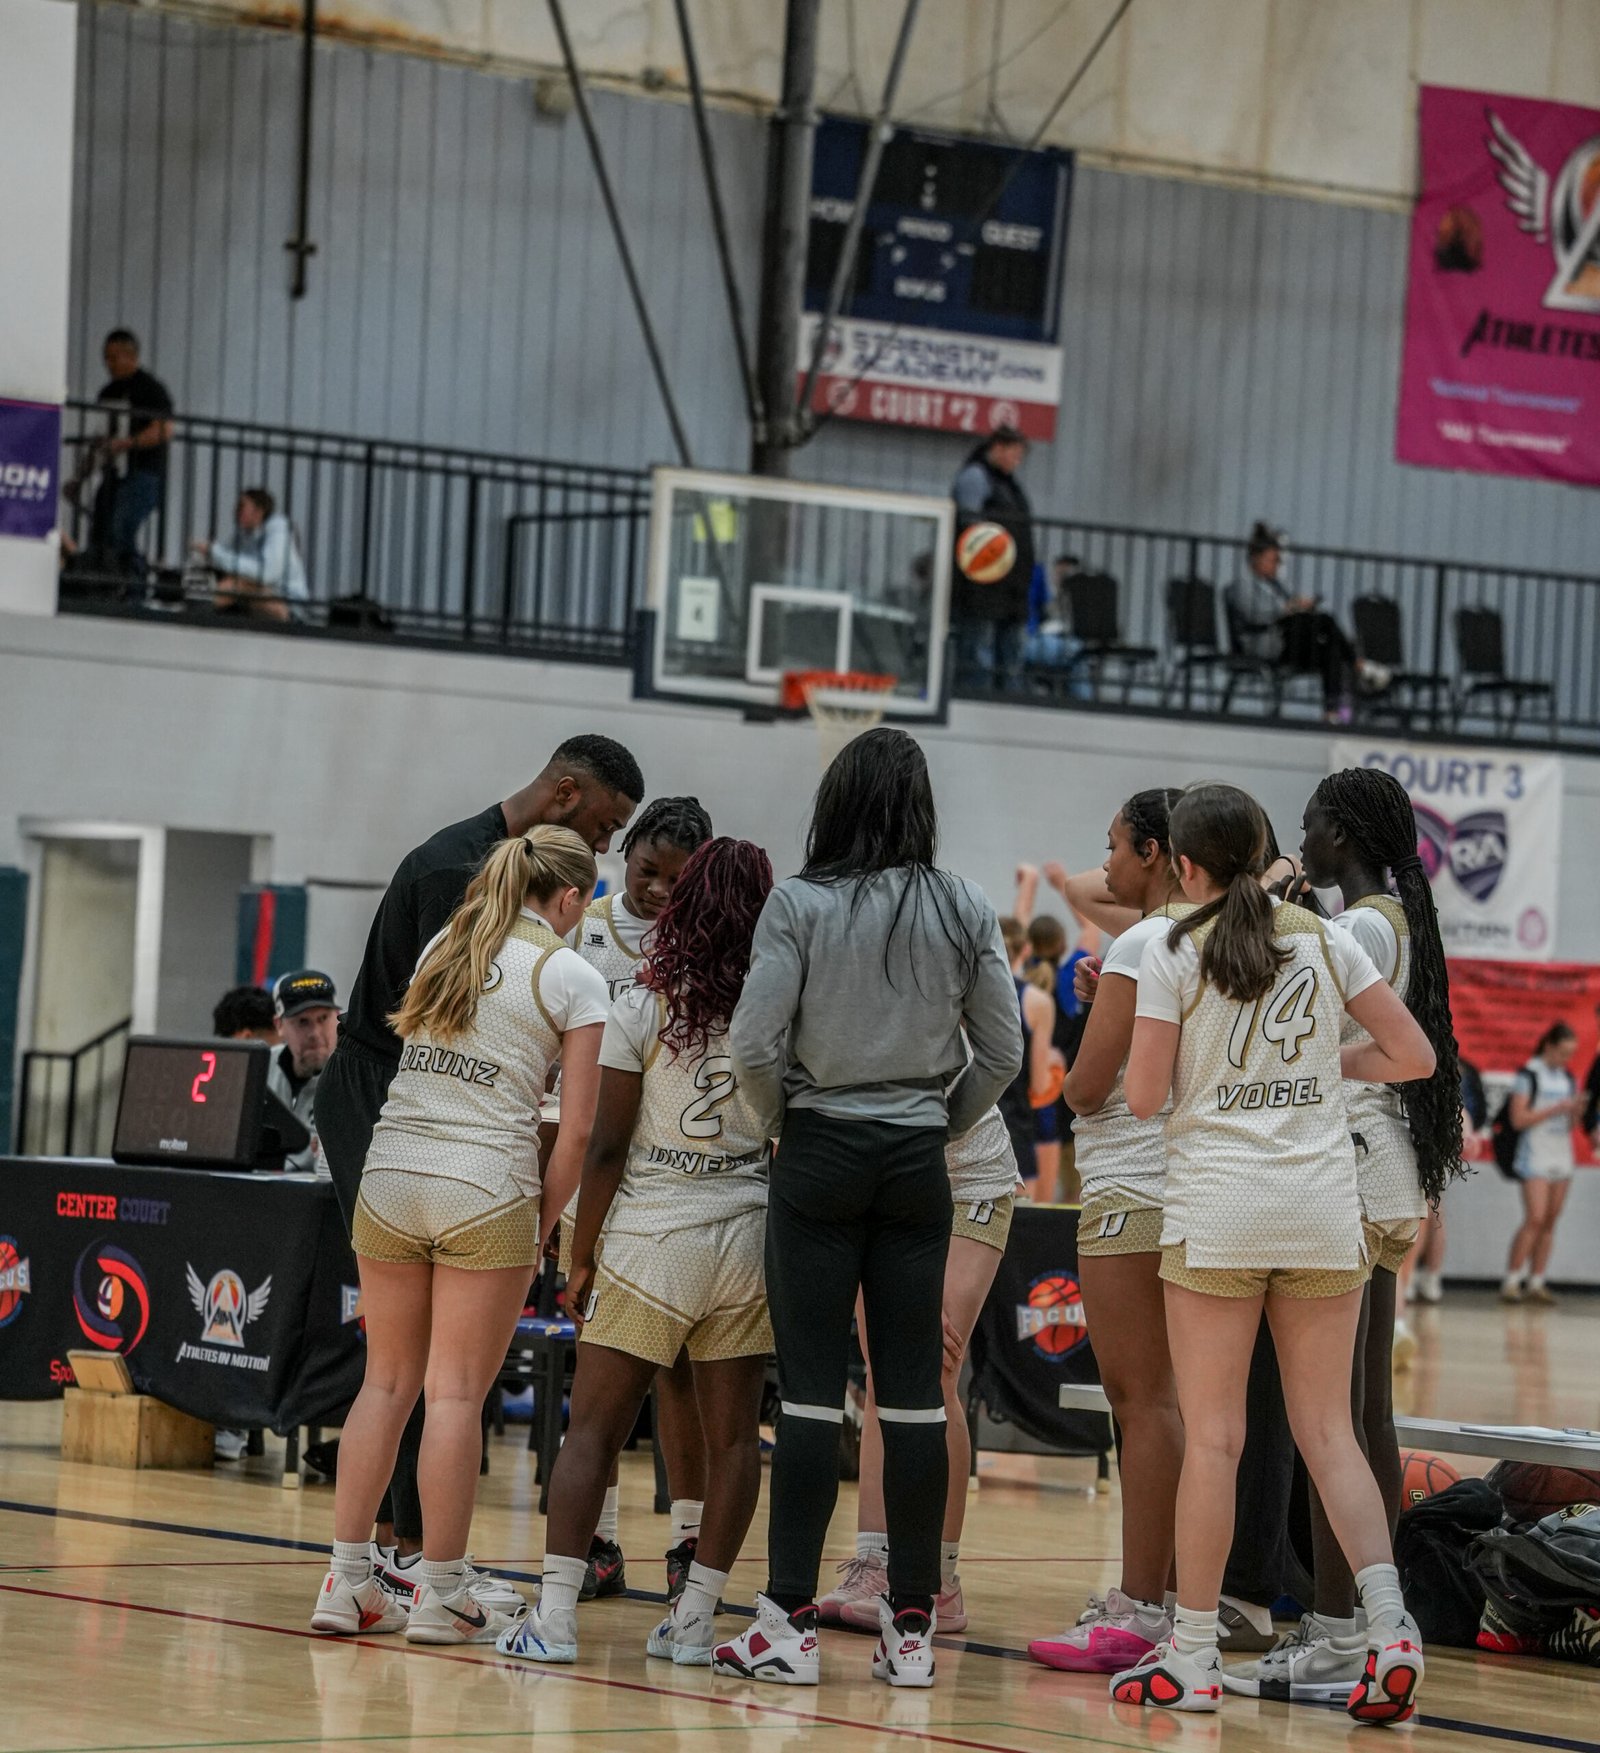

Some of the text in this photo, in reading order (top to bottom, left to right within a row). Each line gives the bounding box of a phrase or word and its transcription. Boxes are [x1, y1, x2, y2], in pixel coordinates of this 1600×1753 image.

[870, 386, 945, 425] COURT
[1504, 763, 1525, 799] 3
[1228, 966, 1317, 1069] 14
[191, 1052, 216, 1102] 2
[1217, 1077, 1322, 1110] VOGEL
[680, 1055, 737, 1139] 2
[57, 1192, 171, 1225] CENTER COURT
[175, 1342, 271, 1372] ATHLETES IN MOTION
[902, 1639, 921, 1649] NIKE
